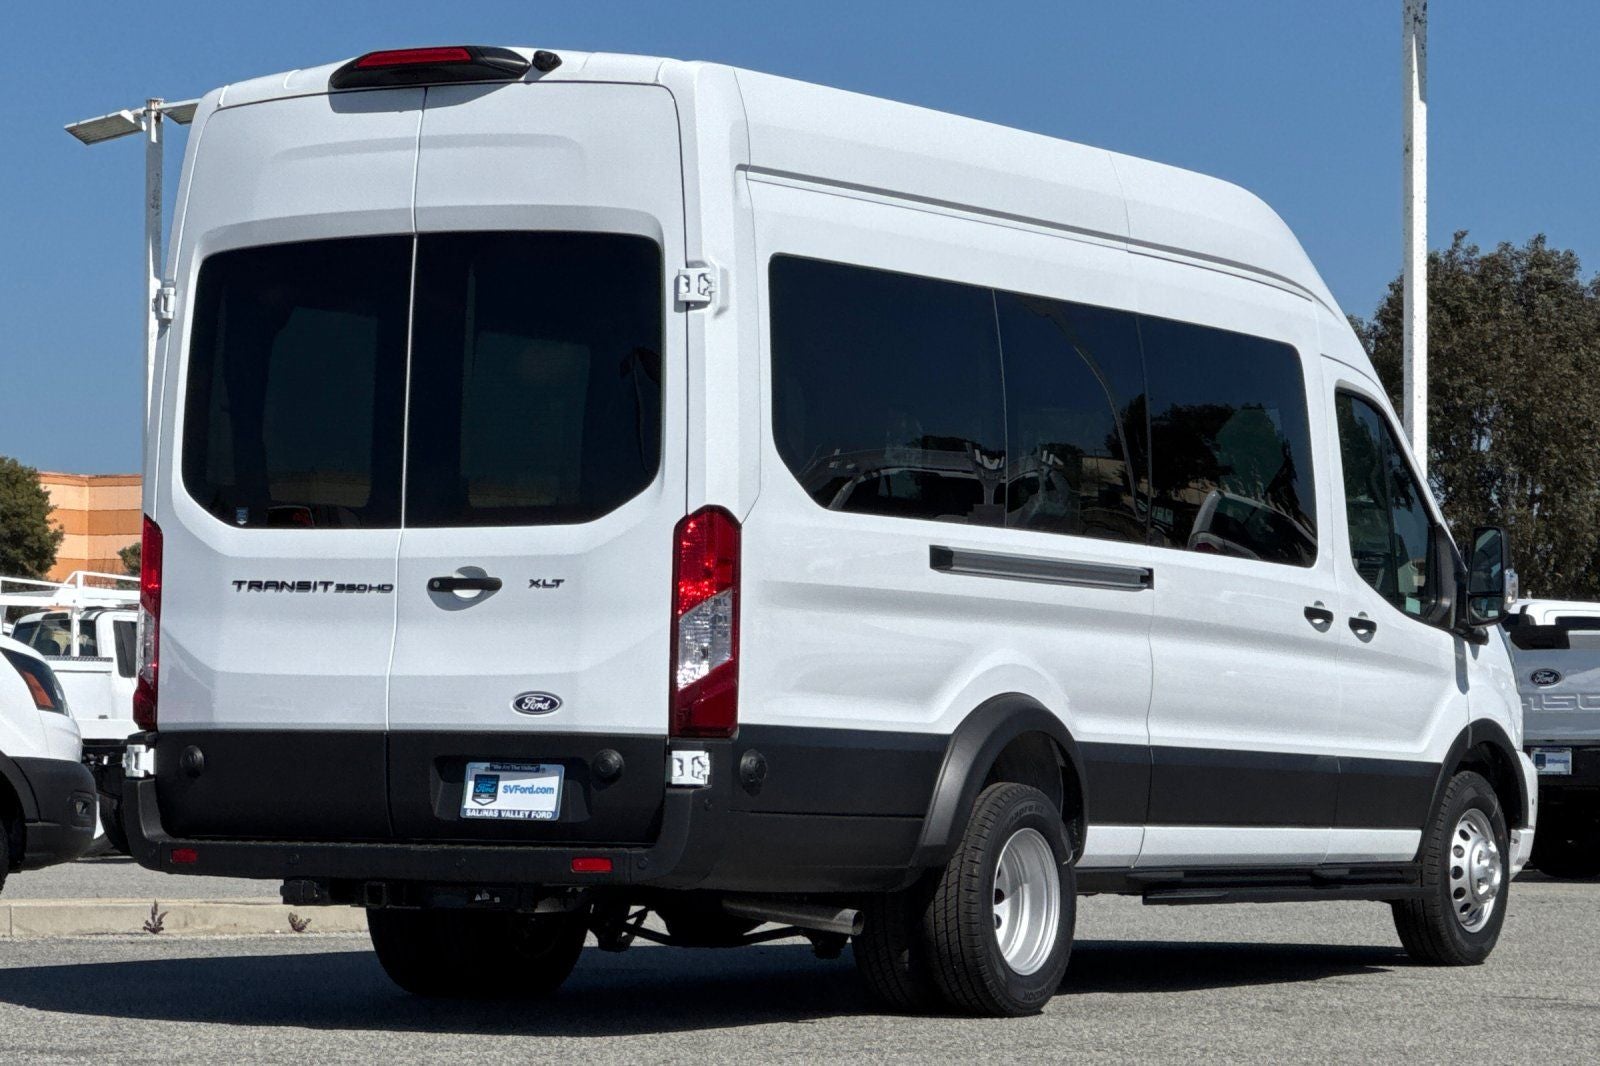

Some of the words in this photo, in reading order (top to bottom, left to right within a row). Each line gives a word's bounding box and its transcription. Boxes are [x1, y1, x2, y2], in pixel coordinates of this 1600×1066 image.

[232, 580, 334, 593] TRANSIT
[528, 579, 565, 589] XLT
[1534, 671, 1556, 684] Ford
[521, 696, 551, 710] Ford
[502, 785, 555, 794] SVFord.com
[466, 808, 499, 818] SALINAS
[501, 809, 529, 819] VALLEY
[531, 811, 553, 819] FORD
